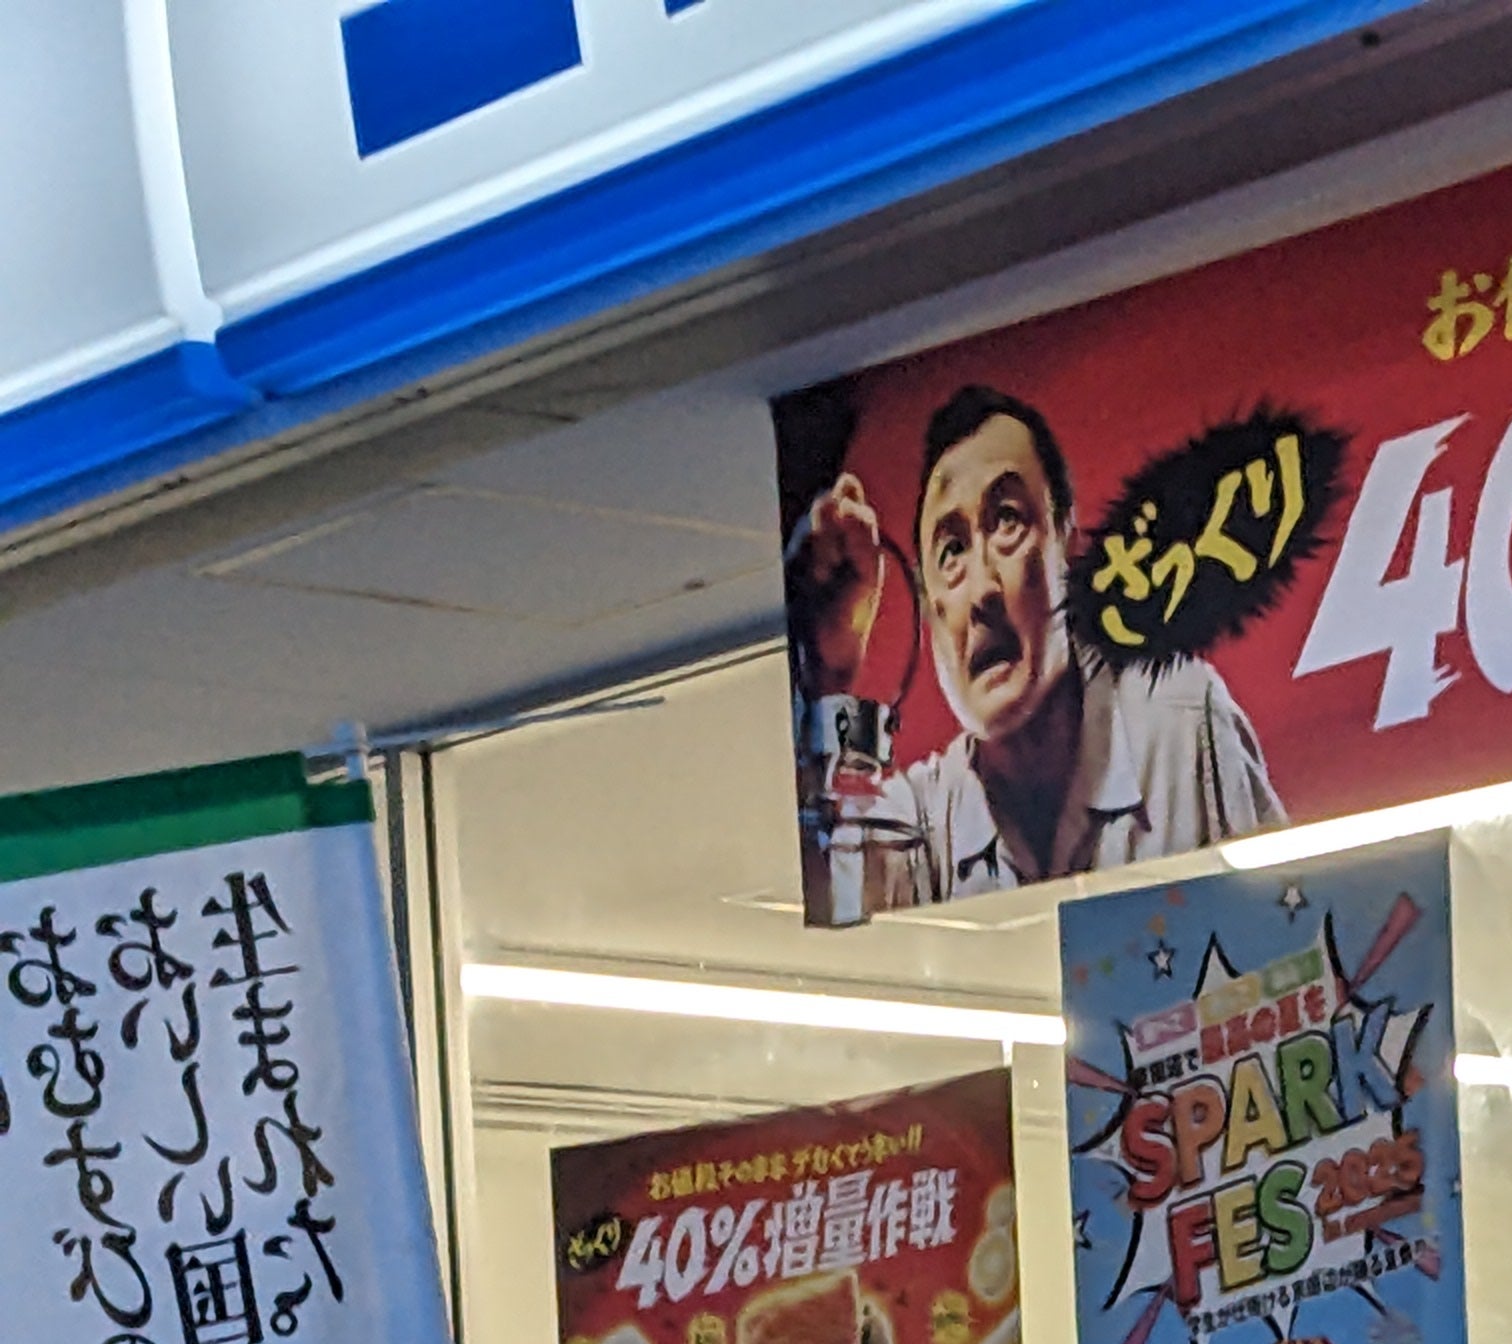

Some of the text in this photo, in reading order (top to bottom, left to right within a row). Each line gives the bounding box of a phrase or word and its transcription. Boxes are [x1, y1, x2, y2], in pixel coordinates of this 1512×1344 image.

[1093, 435, 1305, 648] ざっくり
[1119, 1001, 1408, 1210] SPARK
[615, 1168, 958, 1310] 40%増量作戦
[1166, 1159, 1314, 1319] FES
